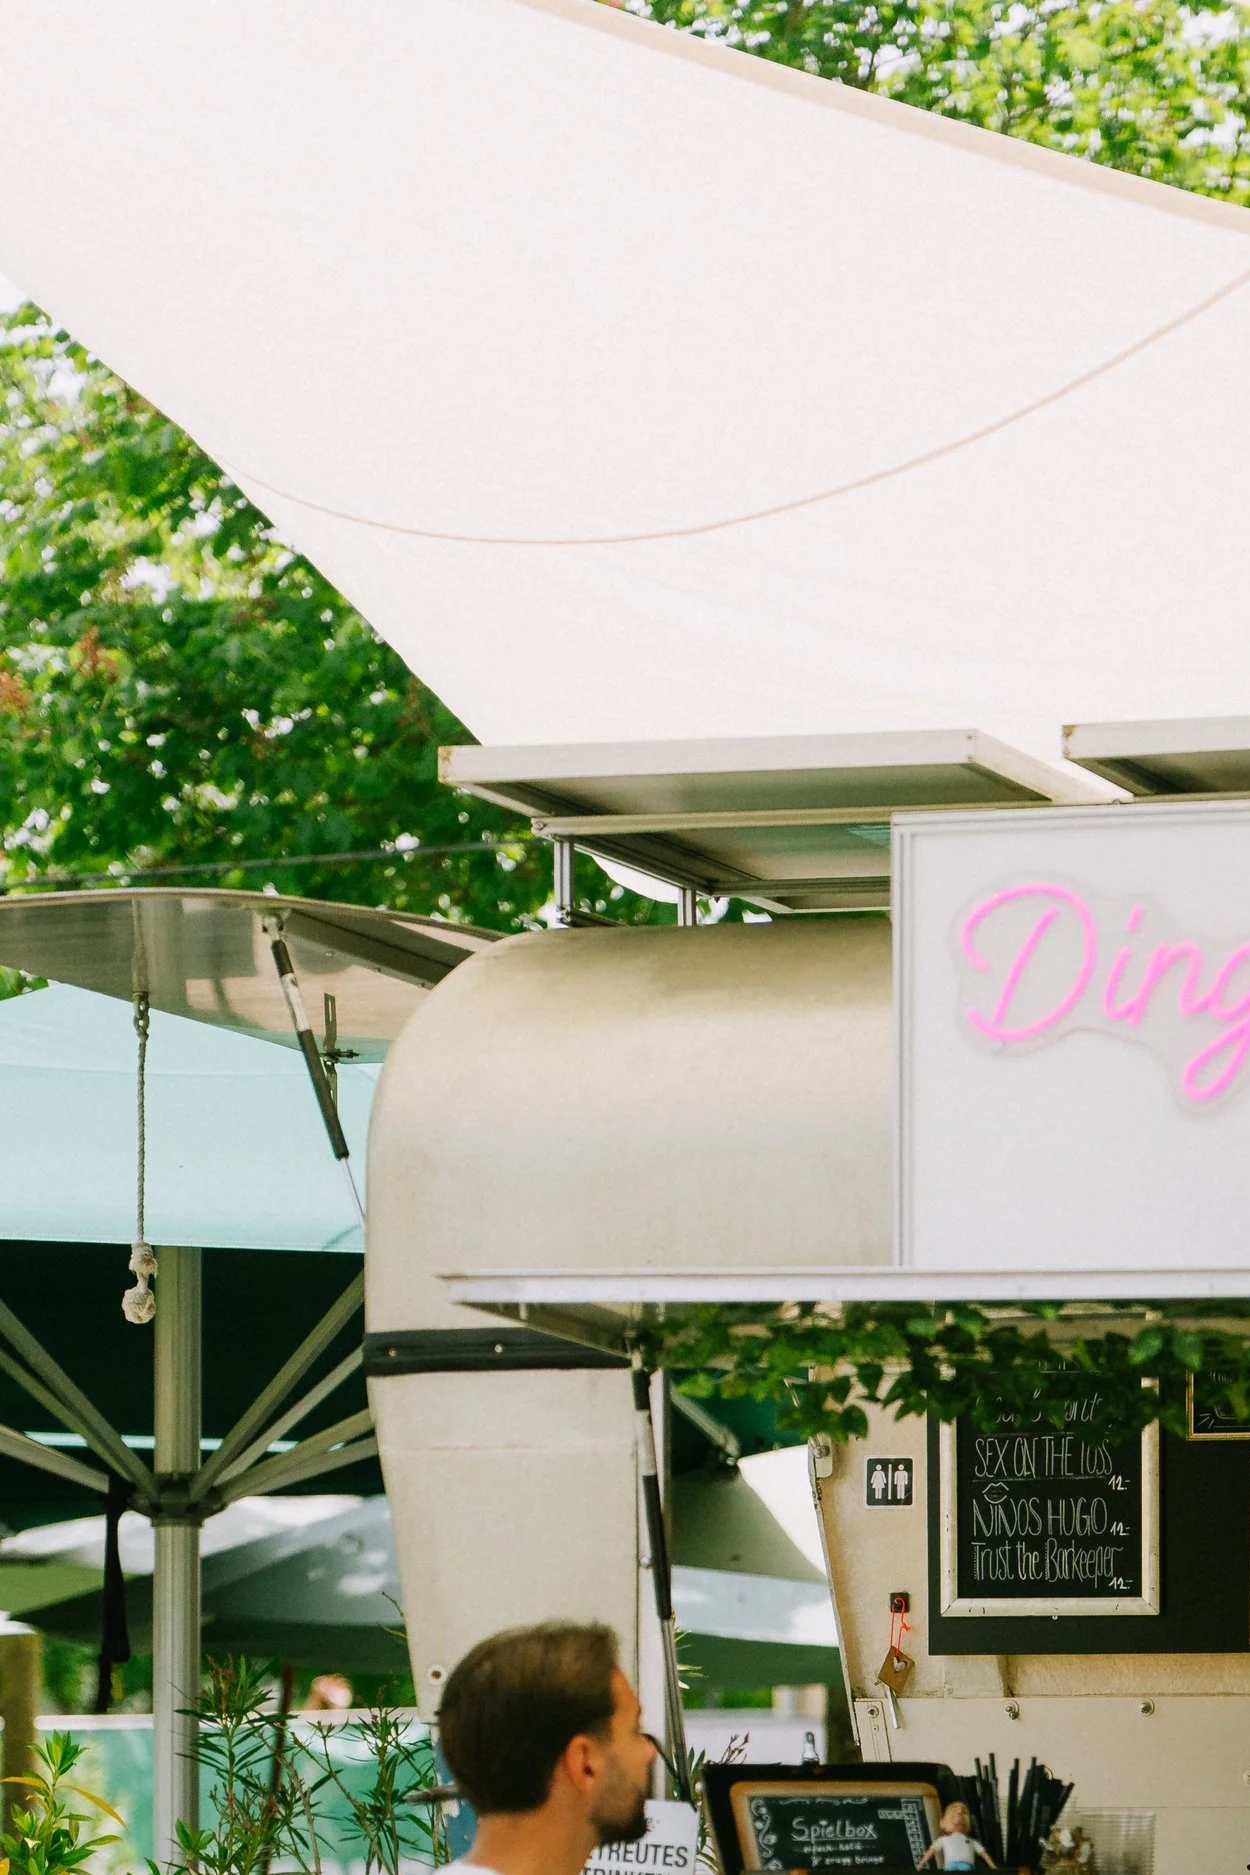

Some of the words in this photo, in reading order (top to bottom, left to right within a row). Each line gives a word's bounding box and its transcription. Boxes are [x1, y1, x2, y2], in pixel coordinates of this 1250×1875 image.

[975, 1438, 1009, 1477] SEX
[1014, 1437, 1038, 1478] ON
[1041, 1436, 1074, 1475] THE
[1048, 1497, 1108, 1537] HUGO
[971, 1540, 1014, 1580] Trust
[1016, 1541, 1042, 1580] the
[792, 1816, 878, 1854] Spielbox
